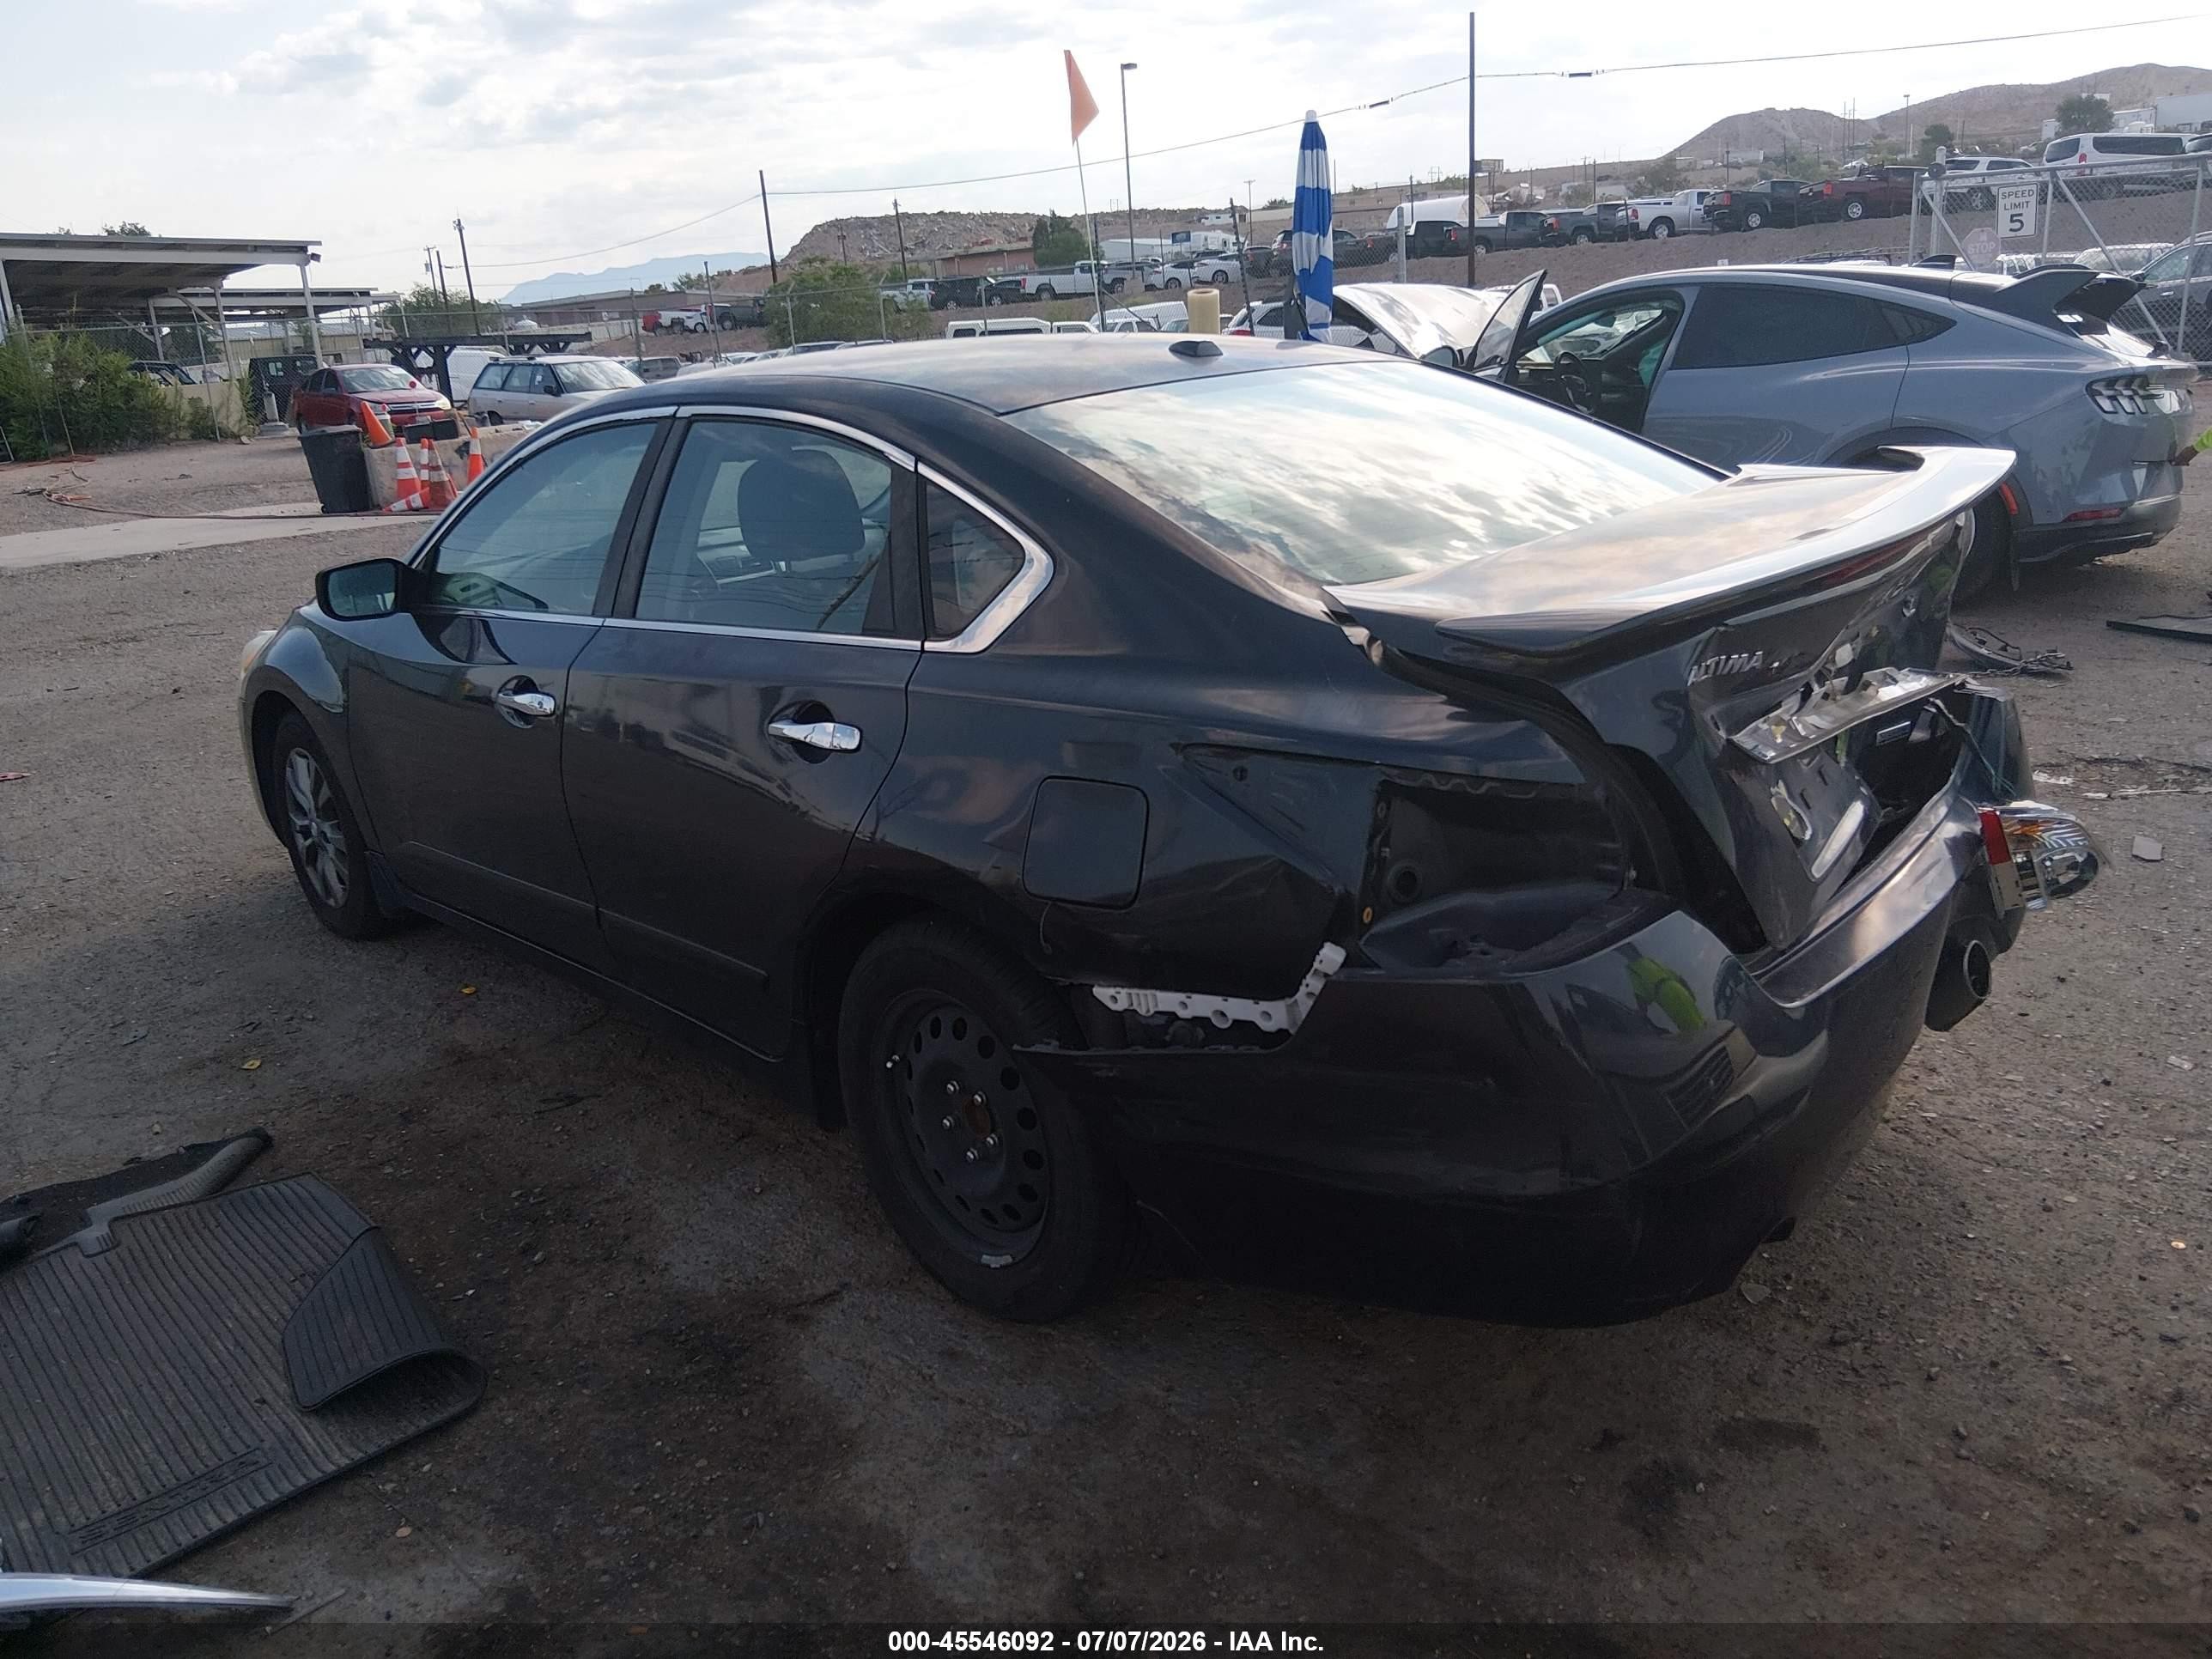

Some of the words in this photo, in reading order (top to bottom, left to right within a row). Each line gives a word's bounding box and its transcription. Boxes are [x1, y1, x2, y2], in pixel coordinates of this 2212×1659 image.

[2001, 189, 2035, 200] SPEED
[2003, 200, 2031, 211] LIMIT
[2008, 212, 2025, 233] 5
[1967, 241, 1996, 255] STOP
